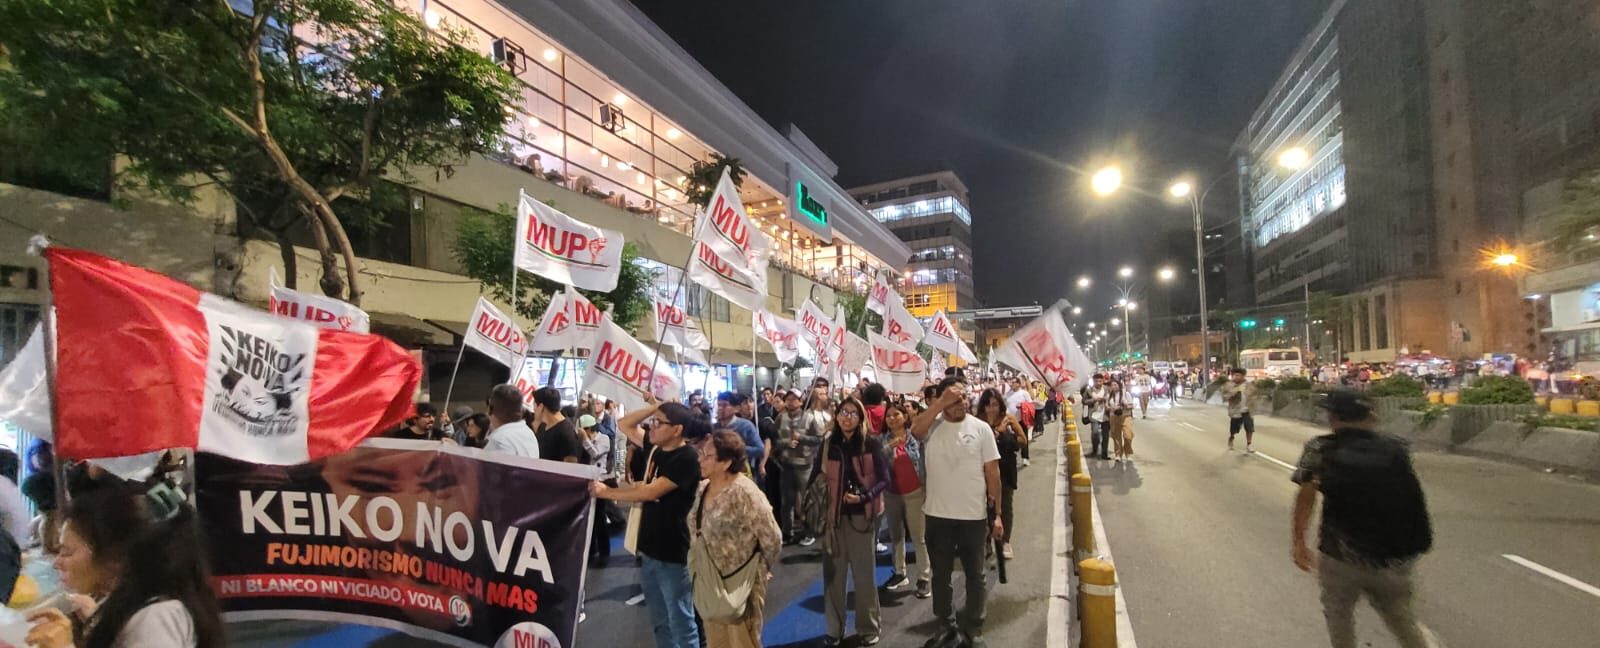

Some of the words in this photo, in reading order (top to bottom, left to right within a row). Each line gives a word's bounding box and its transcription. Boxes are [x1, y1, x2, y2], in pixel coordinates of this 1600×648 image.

[526, 213, 588, 259] MUP
[237, 329, 291, 374] KEIKO
[476, 311, 521, 347] MUP
[236, 348, 264, 381] NO
[597, 340, 652, 388] MUP
[239, 490, 403, 542] KEIKO
[416, 501, 475, 562] NO
[482, 520, 554, 584] VA
[222, 579, 241, 594] NI
[246, 578, 317, 593] BLANCO
[322, 581, 338, 594] NI
[340, 582, 405, 604] VICIADO,
[408, 590, 444, 613] VOTA
[266, 542, 423, 578] FUJIMORISMO
[426, 560, 483, 601] NUNCA
[486, 581, 538, 614] MAS
